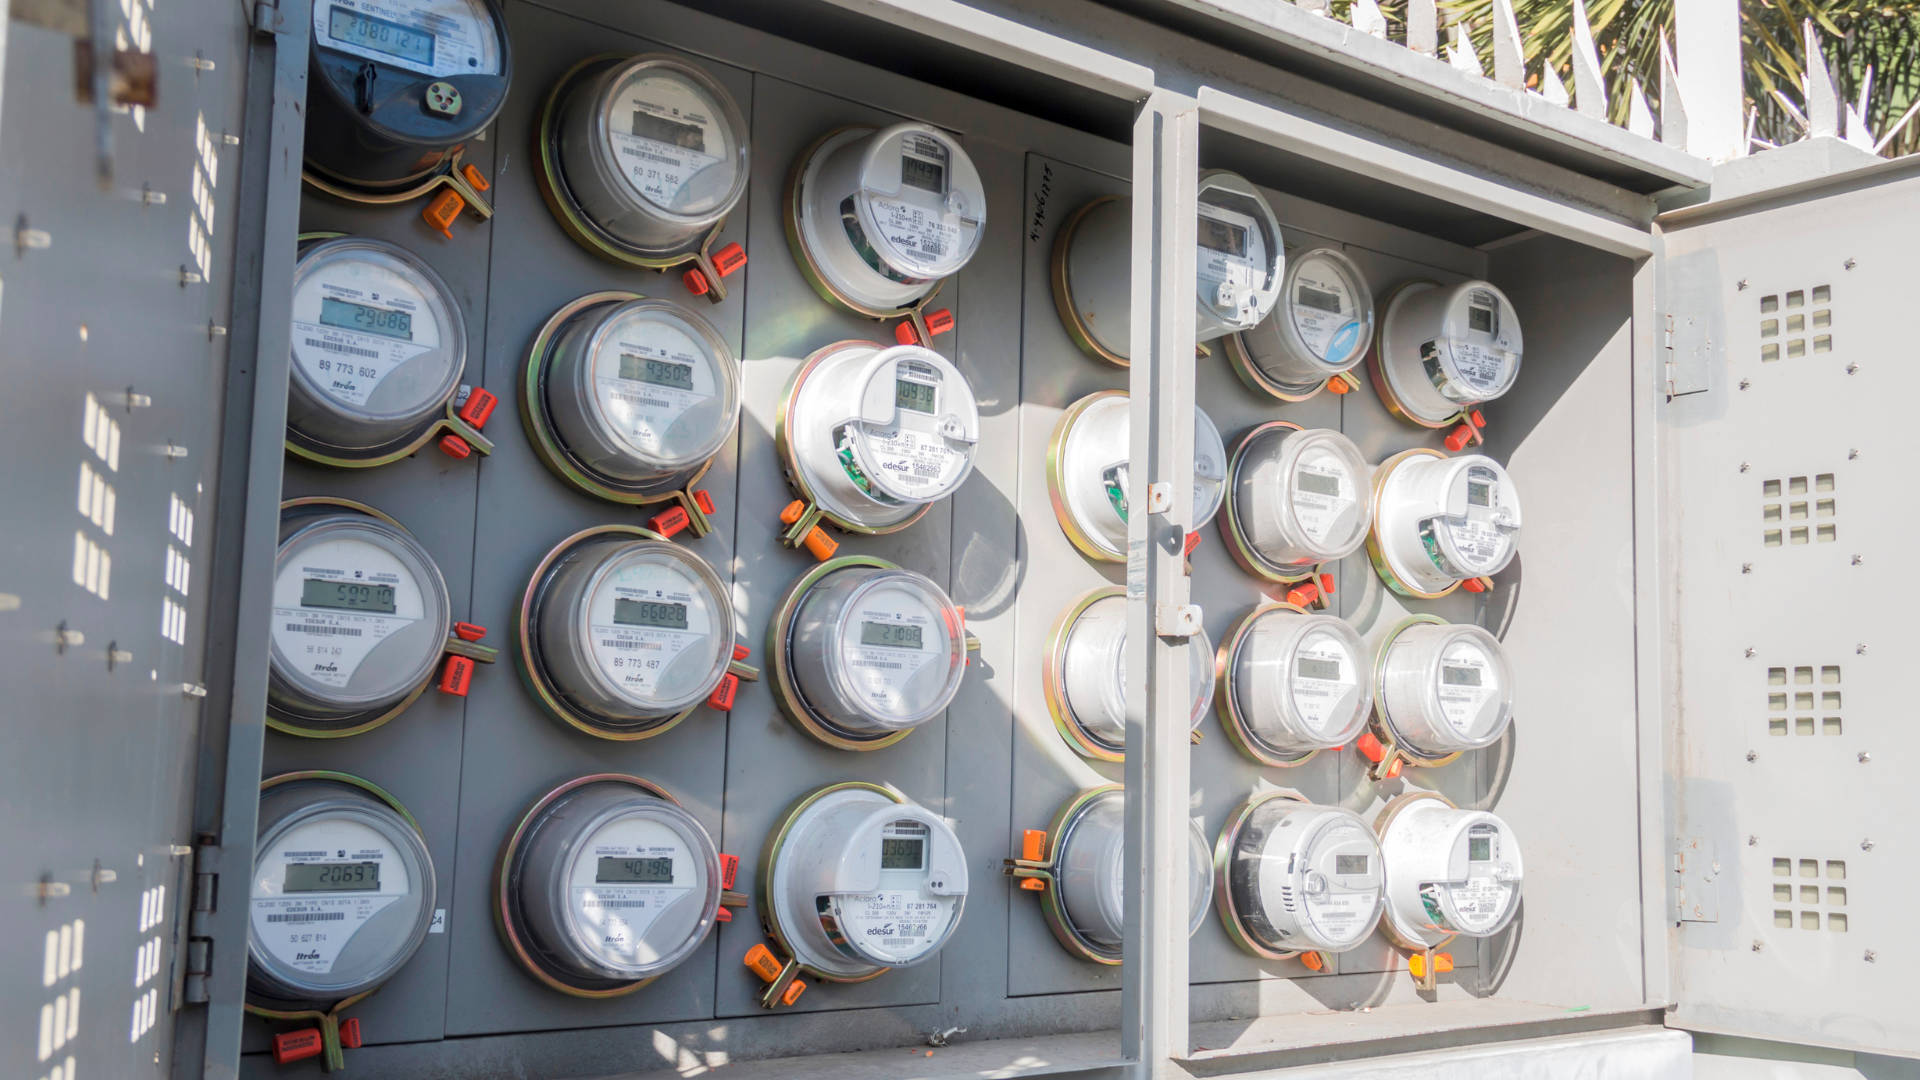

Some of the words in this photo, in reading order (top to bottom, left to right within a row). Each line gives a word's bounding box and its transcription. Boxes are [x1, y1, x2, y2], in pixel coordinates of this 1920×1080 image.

[634, 166, 643, 176] 60
[648, 169, 660, 179] 371
[891, 235, 917, 248] edesur
[355, 308, 407, 331] 29086
[319, 360, 331, 370] 89
[337, 363, 353, 374] 773
[359, 367, 376, 379] 602
[647, 363, 691, 382] 43502
[883, 461, 909, 472] edesur
[338, 585, 391, 605] 59910
[641, 604, 684, 621] 66828
[614, 658, 623, 667] 89
[628, 659, 641, 668] 773
[320, 866, 376, 882] 20697
[625, 861, 668, 875] 40196
[302, 934, 312, 942] 627
[867, 927, 894, 936] edesur
